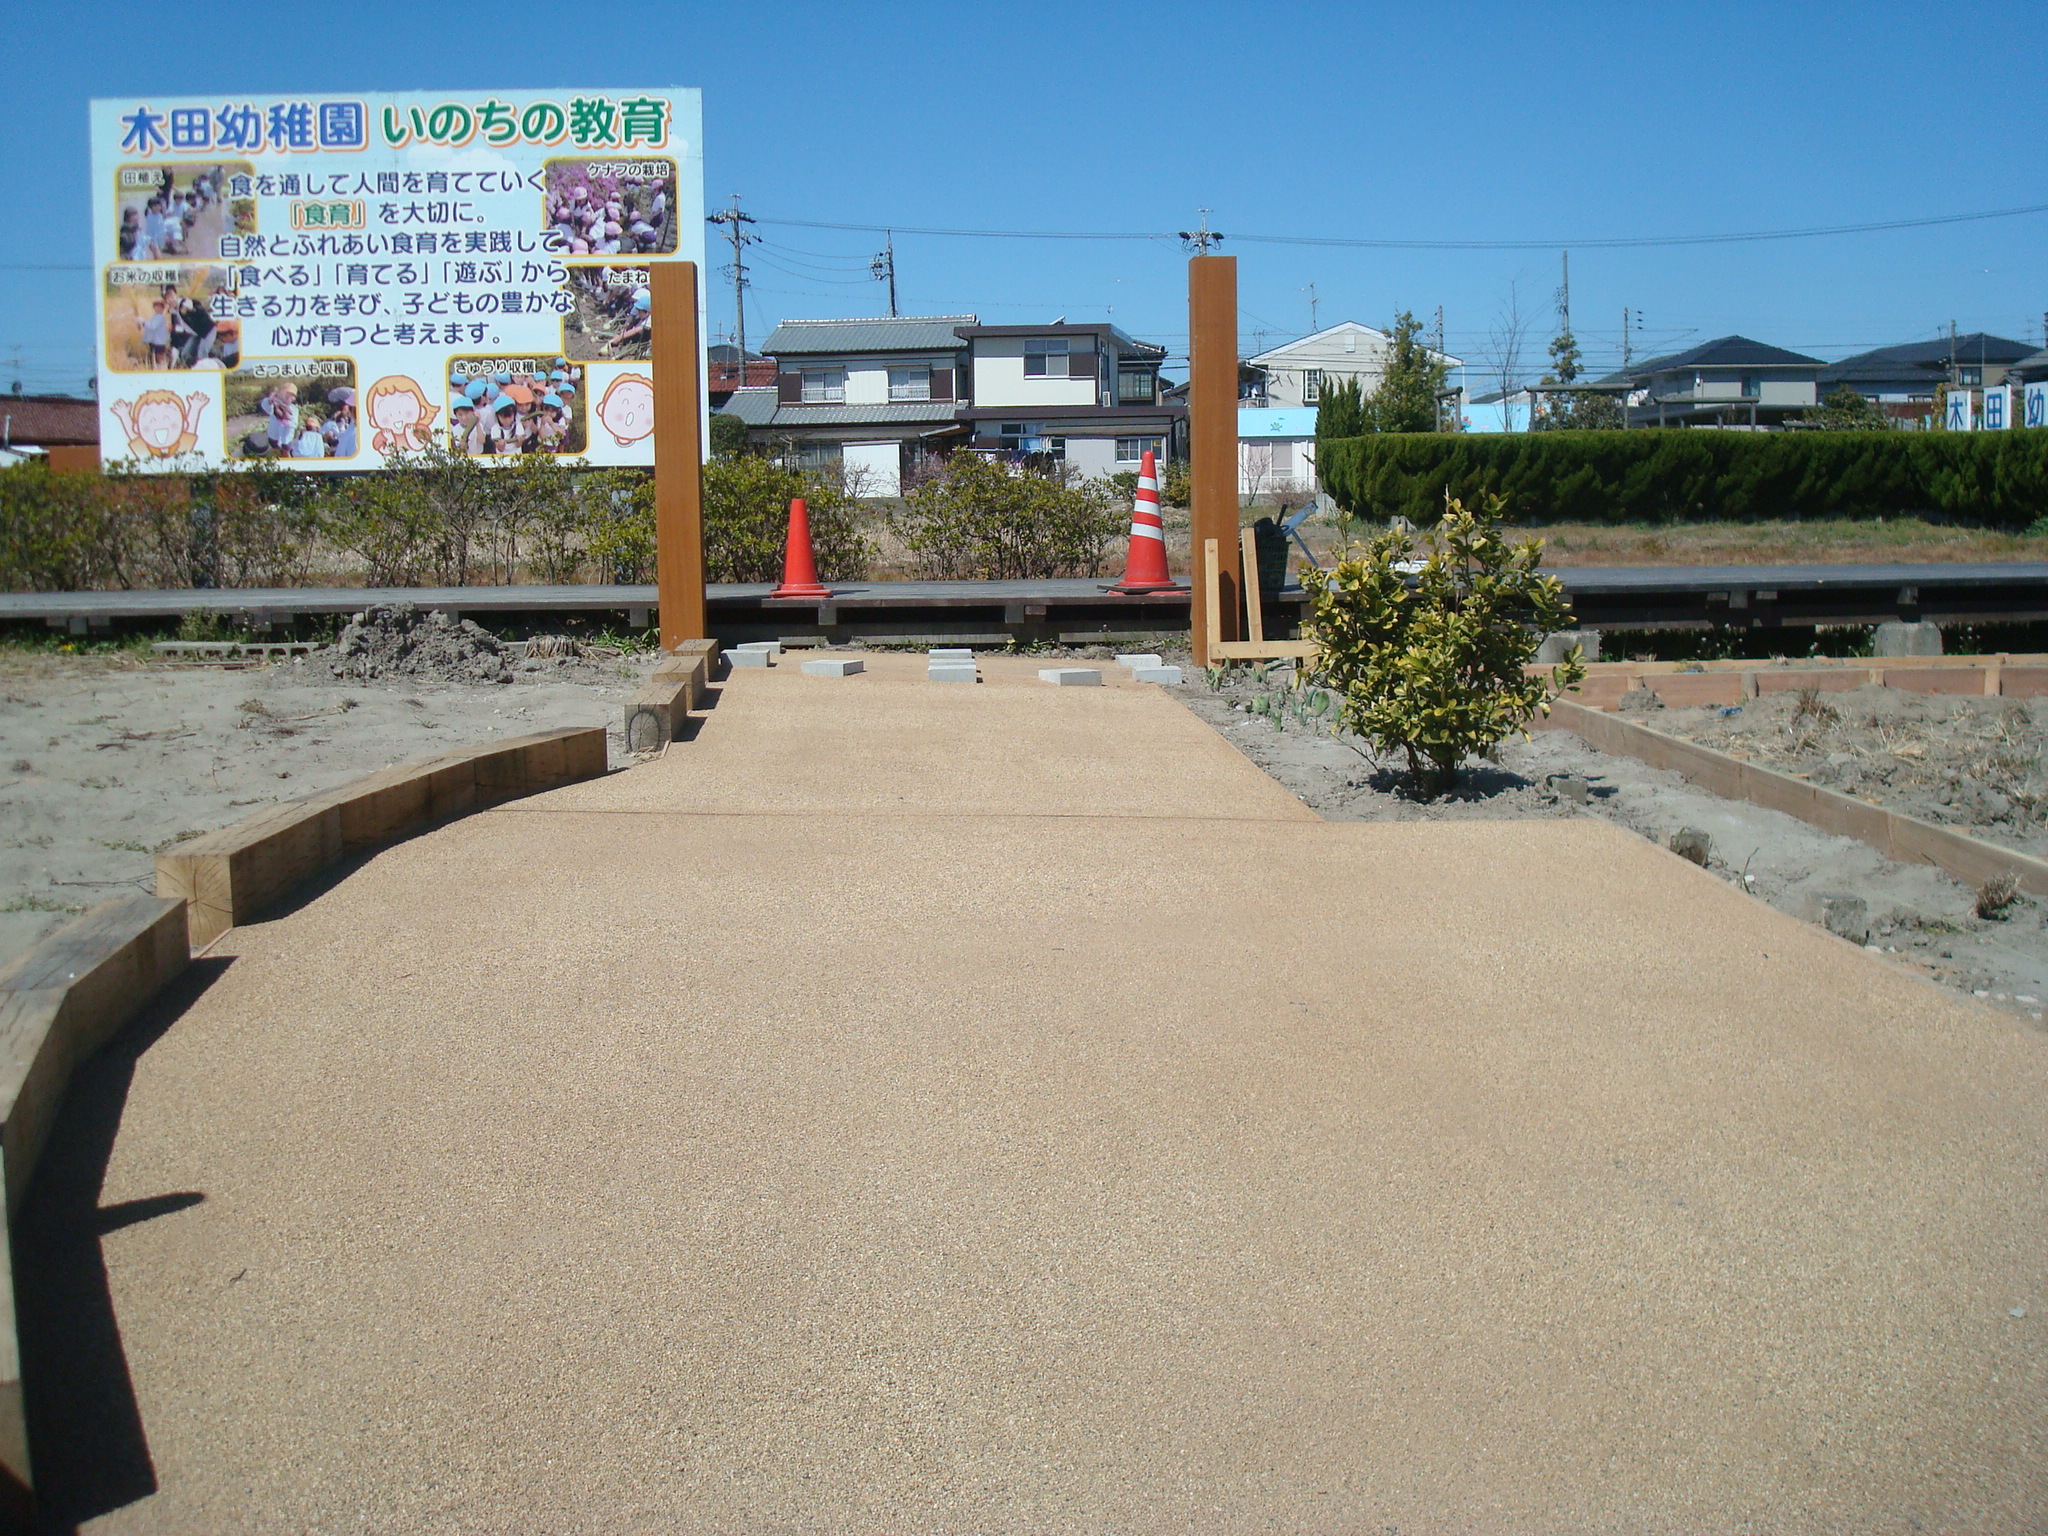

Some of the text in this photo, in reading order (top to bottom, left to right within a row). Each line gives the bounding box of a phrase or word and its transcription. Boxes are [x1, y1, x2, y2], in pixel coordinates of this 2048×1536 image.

[121, 96, 666, 151] 木田幼稚園 いのちの教育
[124, 170, 164, 185] 田植え
[588, 163, 668, 177] ケナフの栽培
[230, 169, 545, 197] 食を通して人間を育てていく
[292, 201, 485, 226] 「食育」 を大切に。
[220, 230, 562, 258] 自然とふれあい食育を実践して
[211, 290, 573, 318] 生きる力を学び、子どもの豊かな
[271, 321, 501, 347] 心が育つと考えます。
[254, 361, 347, 376] さつまいも収穫
[455, 360, 537, 375] きゅうり収穫
